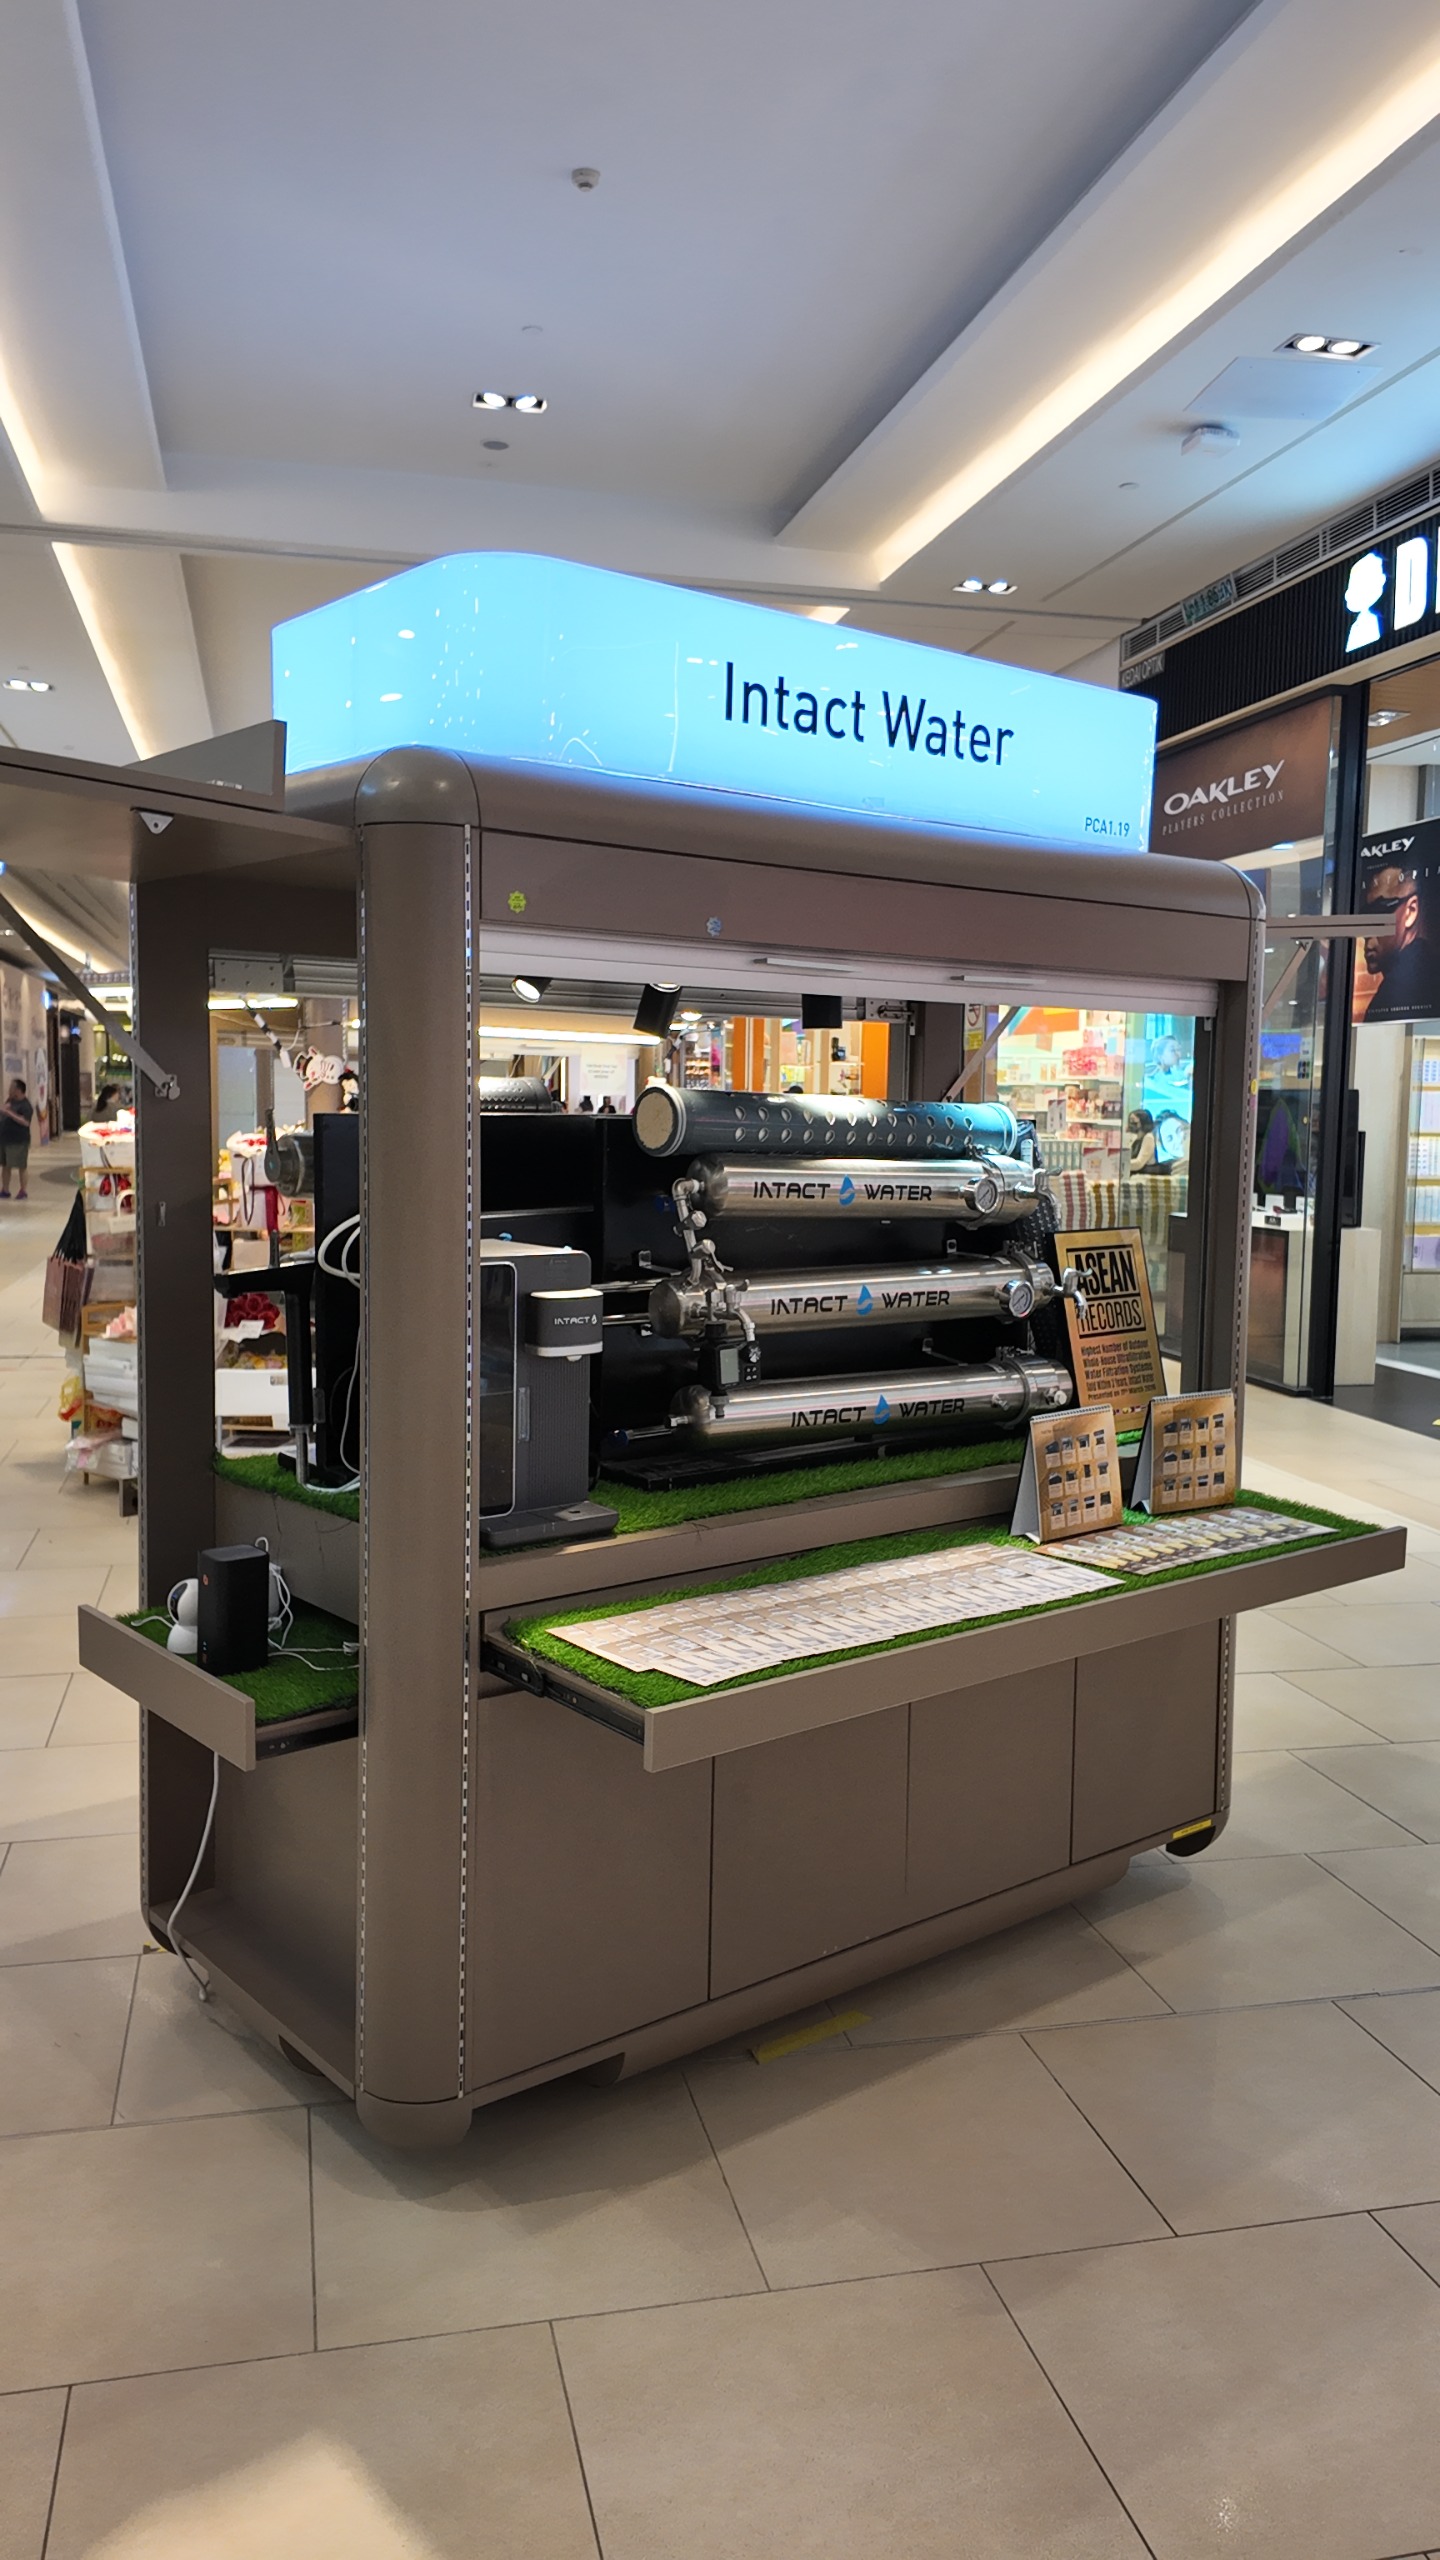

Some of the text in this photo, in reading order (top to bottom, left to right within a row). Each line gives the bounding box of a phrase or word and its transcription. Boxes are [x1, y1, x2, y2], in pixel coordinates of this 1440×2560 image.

[1394, 526, 1440, 631] D
[724, 661, 1014, 766] Intact Water
[1163, 759, 1286, 816] OAKLEY
[1084, 816, 1131, 837] PCA1.19
[1161, 789, 1285, 836] PLAYERS COLLECTION
[753, 1181, 933, 1201] INTACT WATER
[1074, 1249, 1137, 1296] ASEAN
[770, 1290, 951, 1315] INTACT WATER
[1077, 1298, 1142, 1333] RECORDS
[554, 1316, 591, 1325] INTACT
[791, 1398, 966, 1428] INTACT WATER
